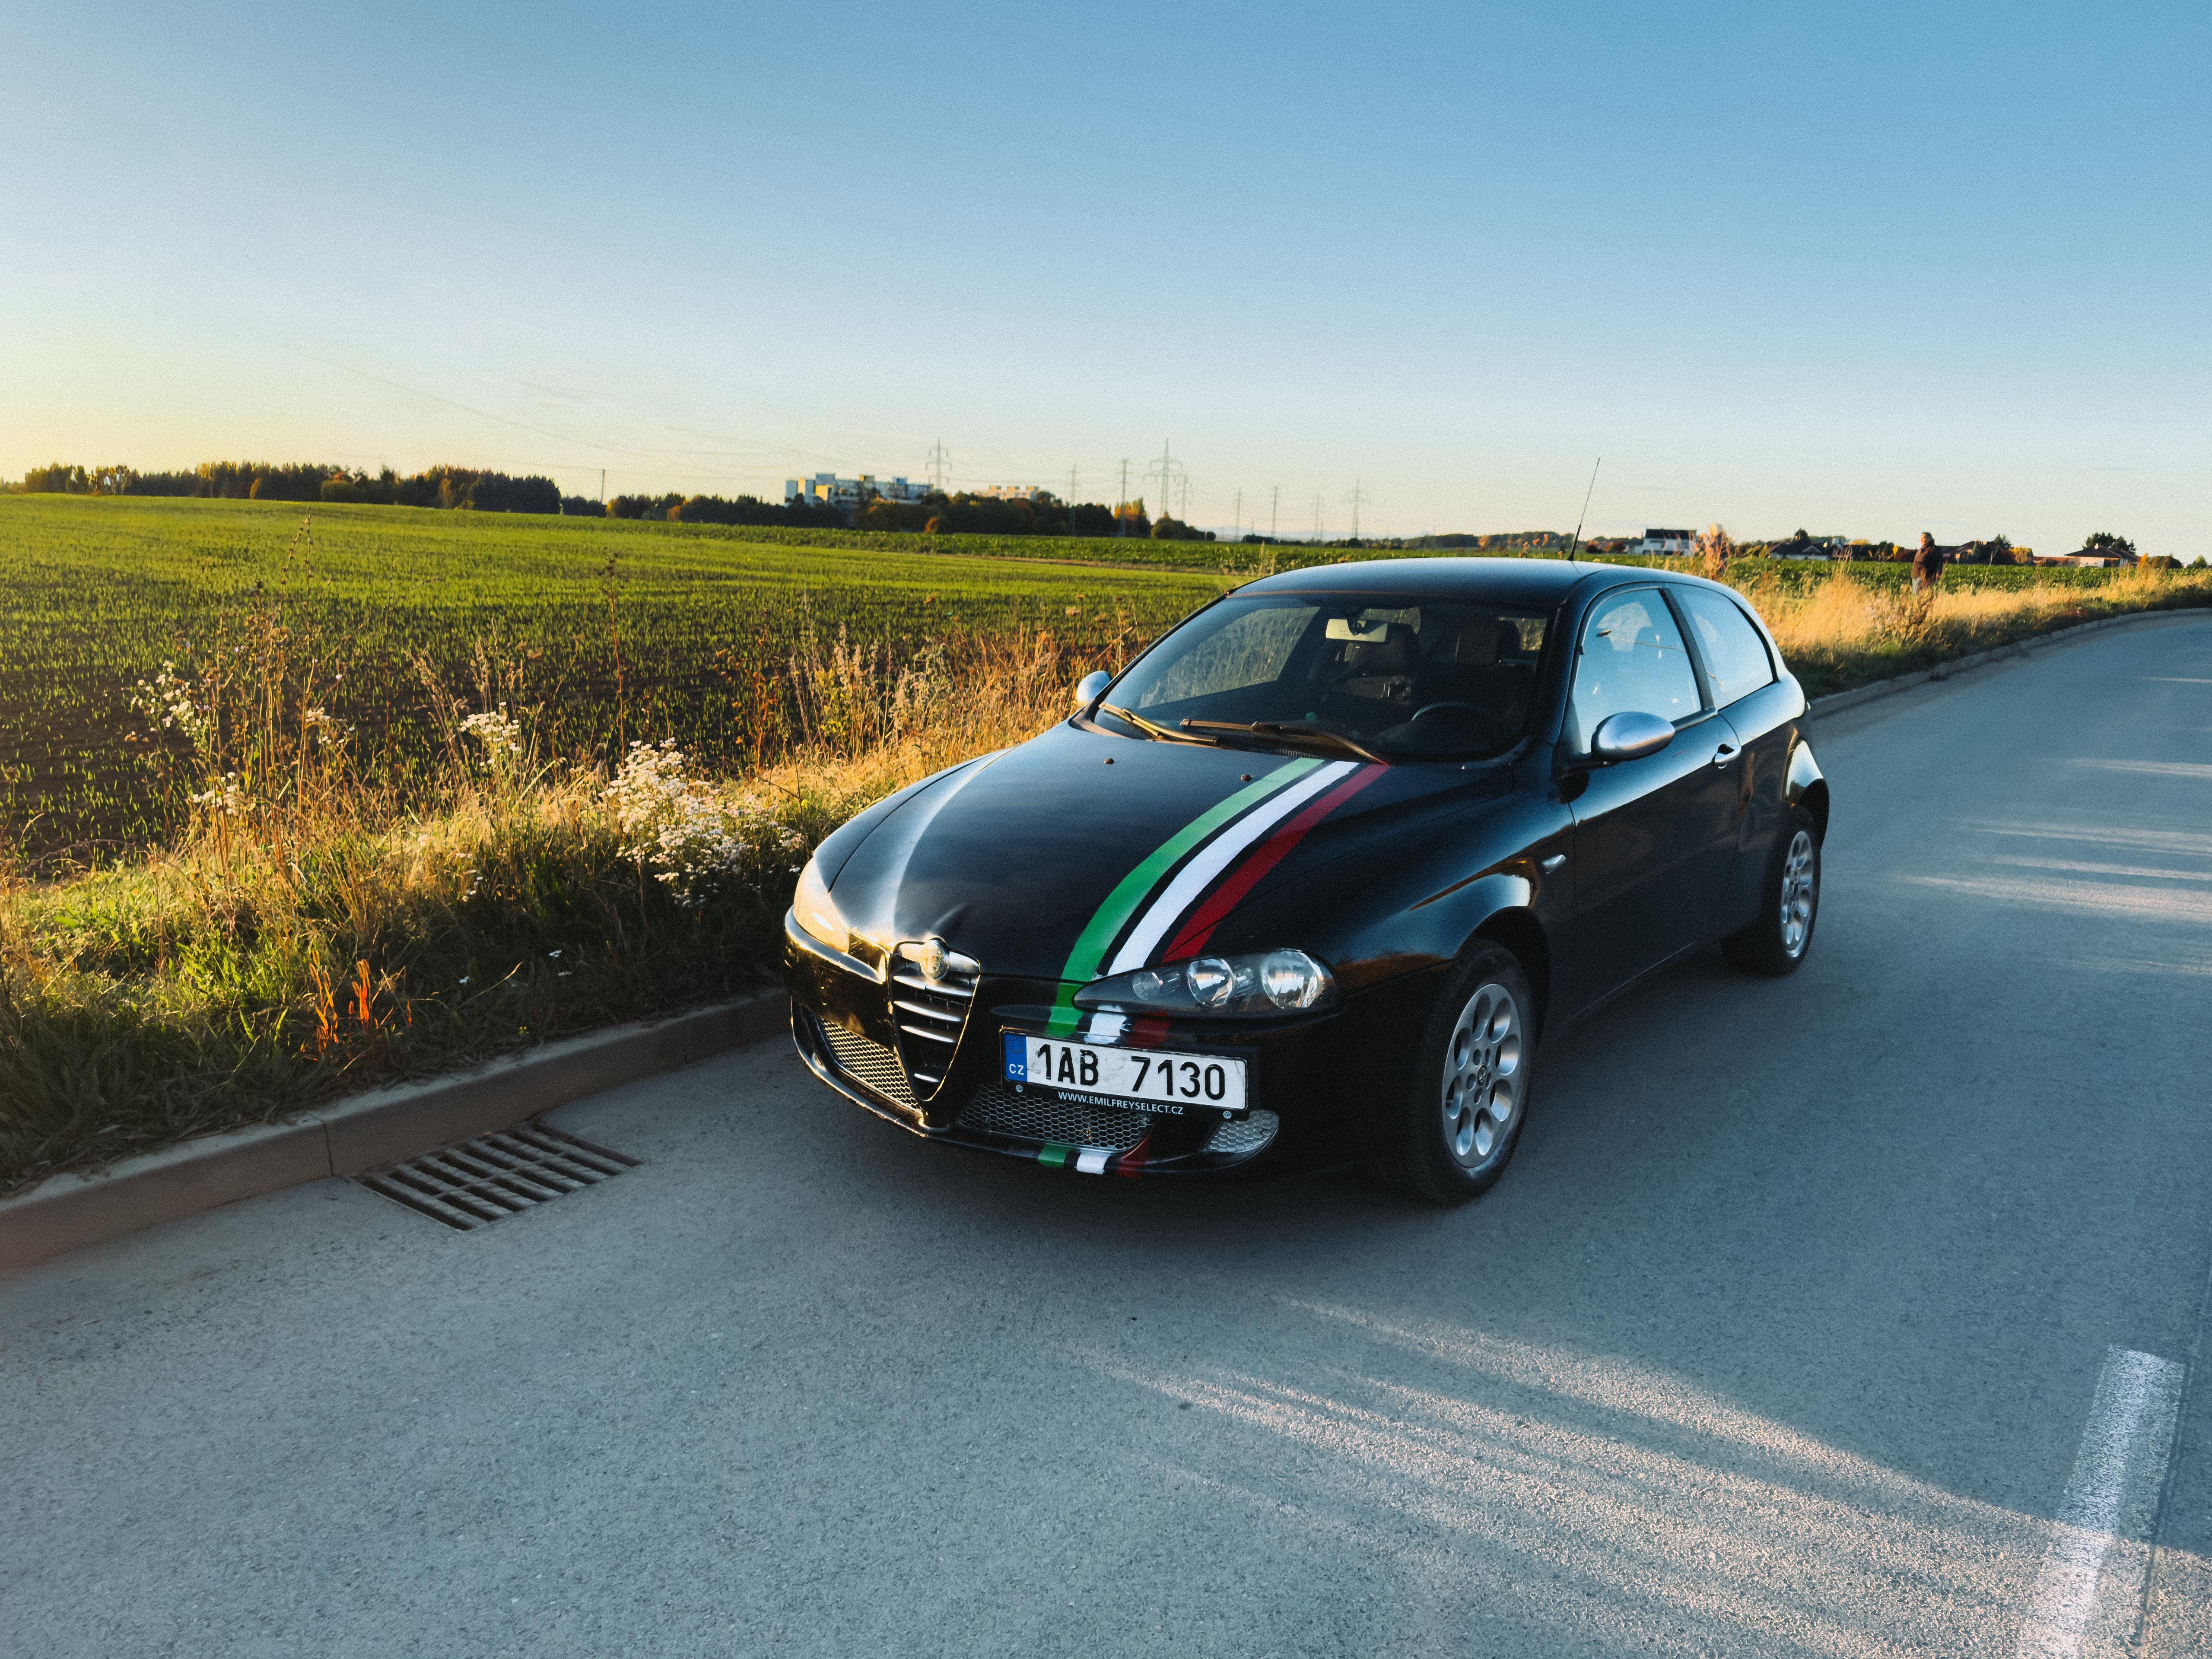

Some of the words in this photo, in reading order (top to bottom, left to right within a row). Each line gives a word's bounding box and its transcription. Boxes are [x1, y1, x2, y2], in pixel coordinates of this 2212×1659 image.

[1009, 1064, 1024, 1075] CZ
[1038, 1044, 1099, 1086] 1AB
[1131, 1055, 1225, 1100] 7130
[1058, 1091, 1183, 1115] WWW.EMILFREYSELECT.CZ
